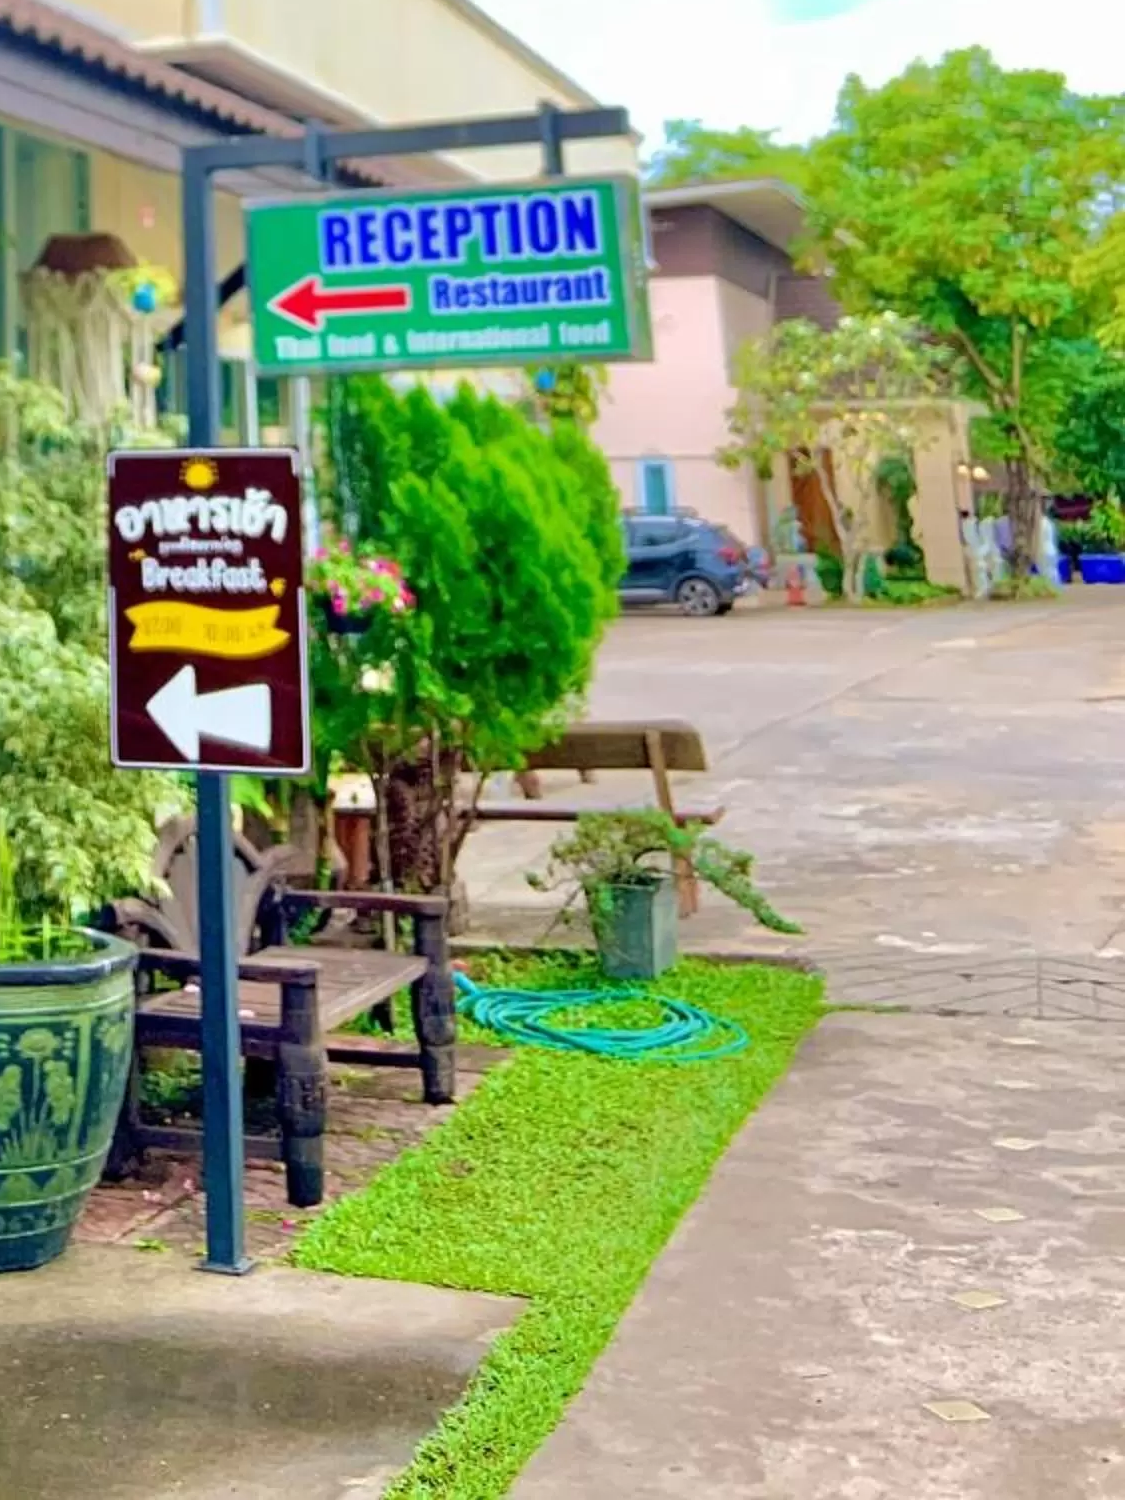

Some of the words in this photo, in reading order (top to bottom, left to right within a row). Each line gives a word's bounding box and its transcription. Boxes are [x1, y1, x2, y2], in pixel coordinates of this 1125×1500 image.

[321, 192, 599, 269] RECEPTION
[430, 269, 608, 311] Restaurant
[114, 486, 288, 545] อาหารเช้า
[141, 556, 267, 593] Breakfast
